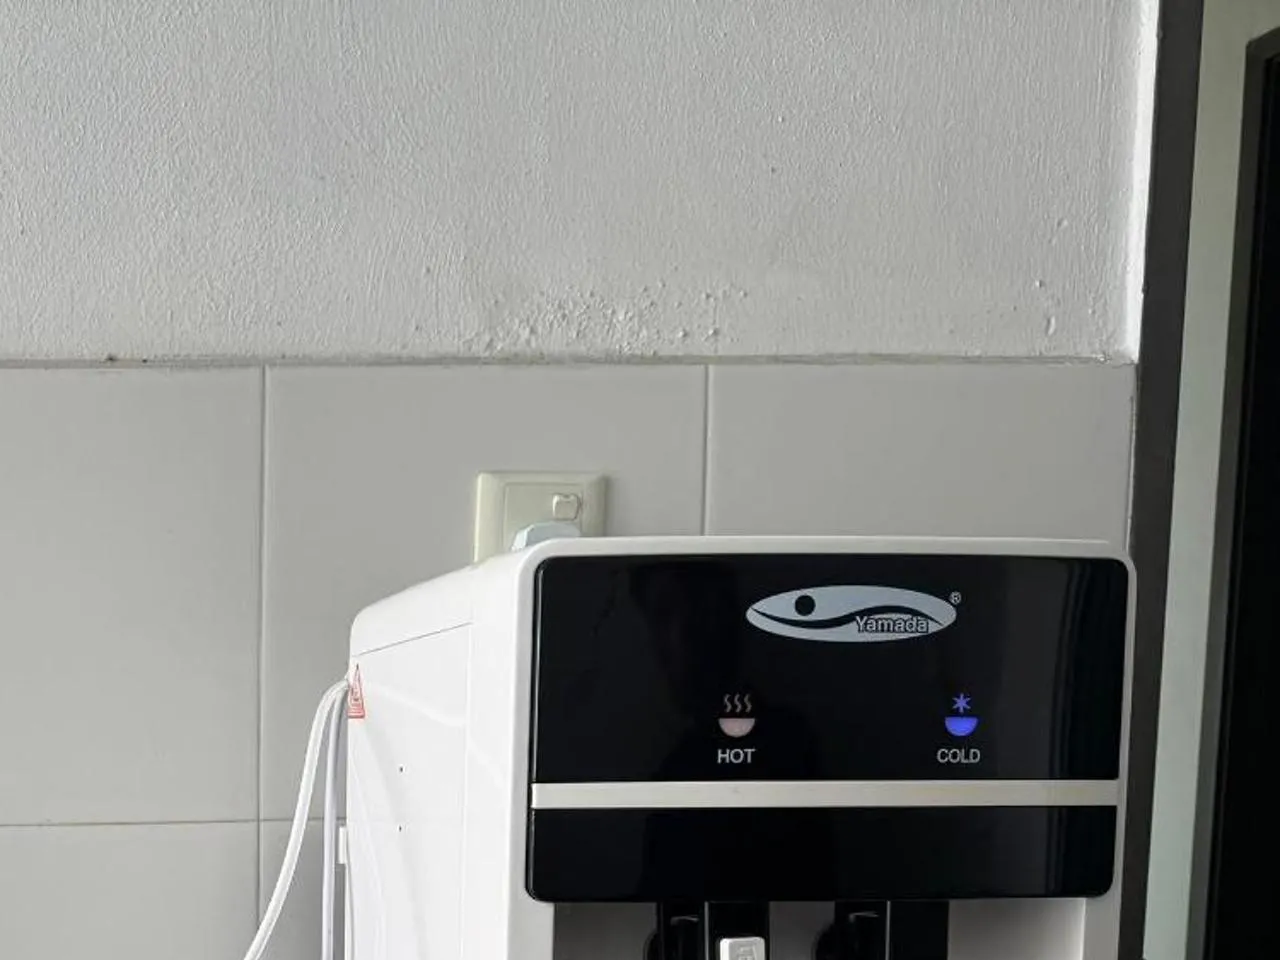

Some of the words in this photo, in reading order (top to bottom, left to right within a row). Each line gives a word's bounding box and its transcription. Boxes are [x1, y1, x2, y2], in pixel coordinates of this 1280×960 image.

[855, 616, 929, 633] Yamada
[717, 748, 756, 764] HOT
[936, 748, 981, 764] COLD
